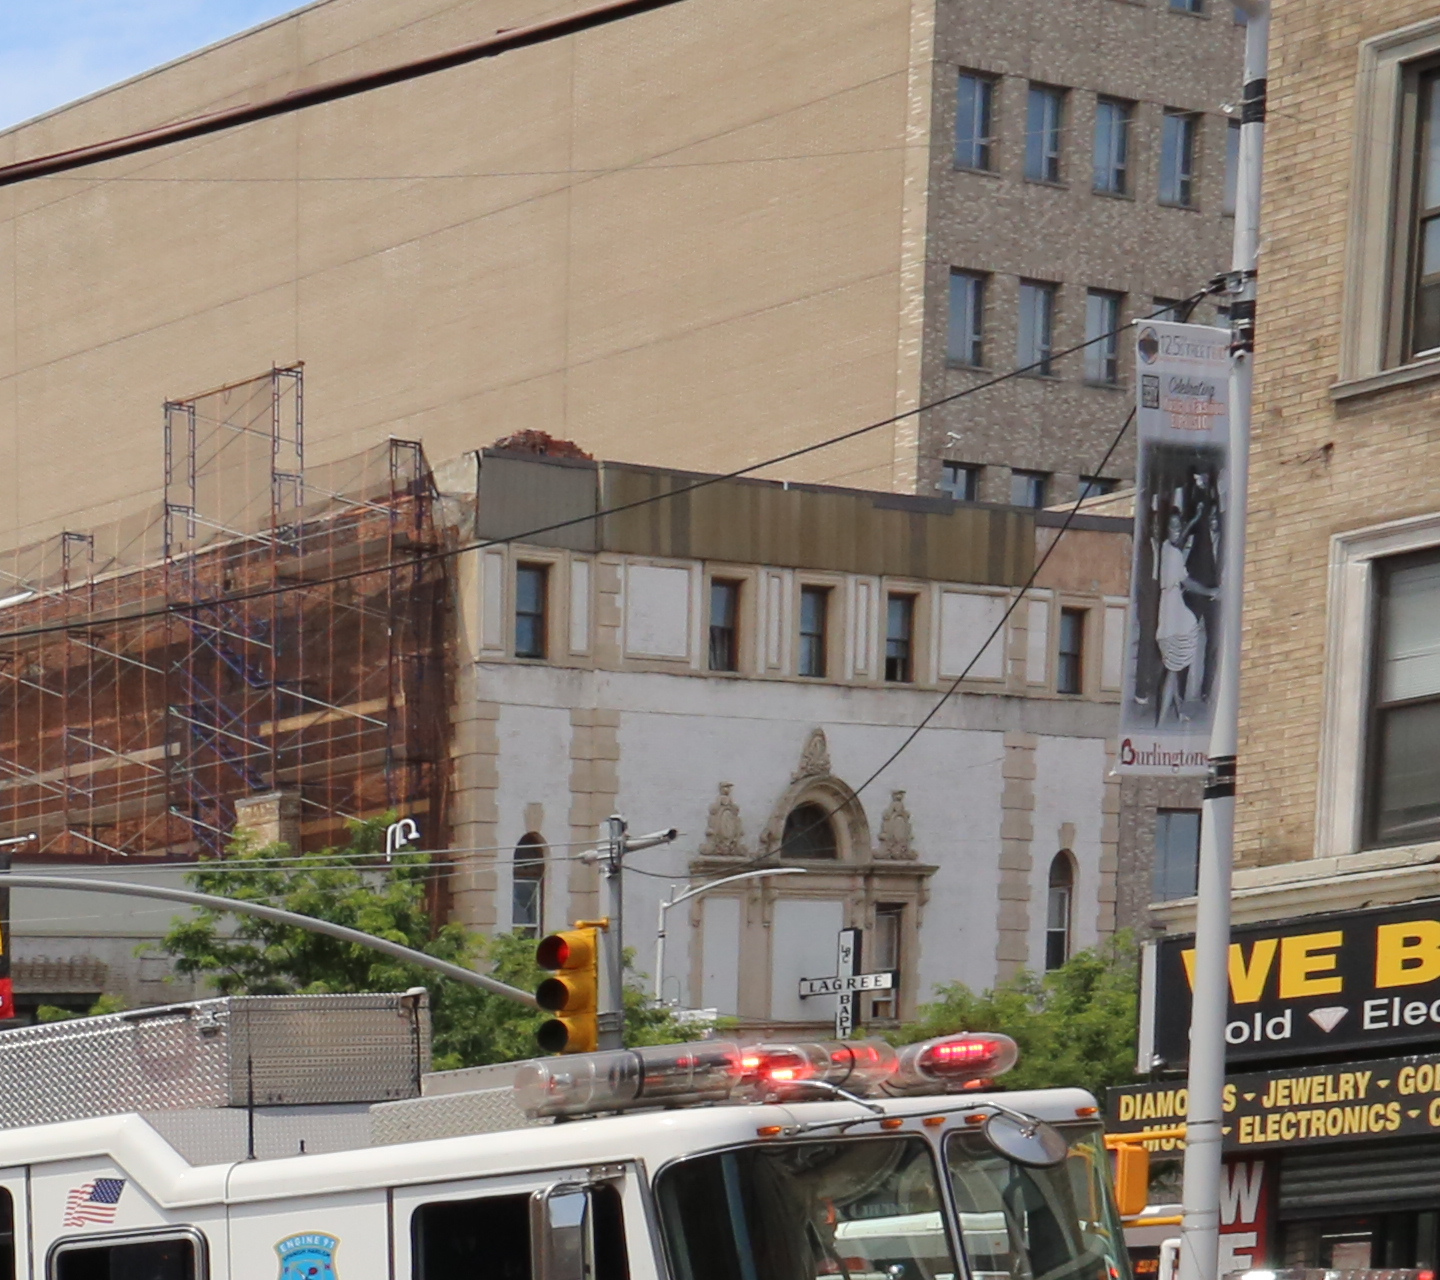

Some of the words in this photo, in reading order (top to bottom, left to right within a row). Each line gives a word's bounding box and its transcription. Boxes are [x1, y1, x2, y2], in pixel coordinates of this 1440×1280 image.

[1120, 738, 1210, 773] Burlington
[839, 994, 851, 1040] BAPT
[1189, 1008, 1293, 1045] old
[1120, 1083, 1238, 1121] DIAMOS
[1262, 1070, 1372, 1109] JEWELRY
[1238, 1101, 1401, 1145] ELECTRONICS
[279, 1234, 321, 1253] ENGINE
[322, 1236, 335, 1250] 91
